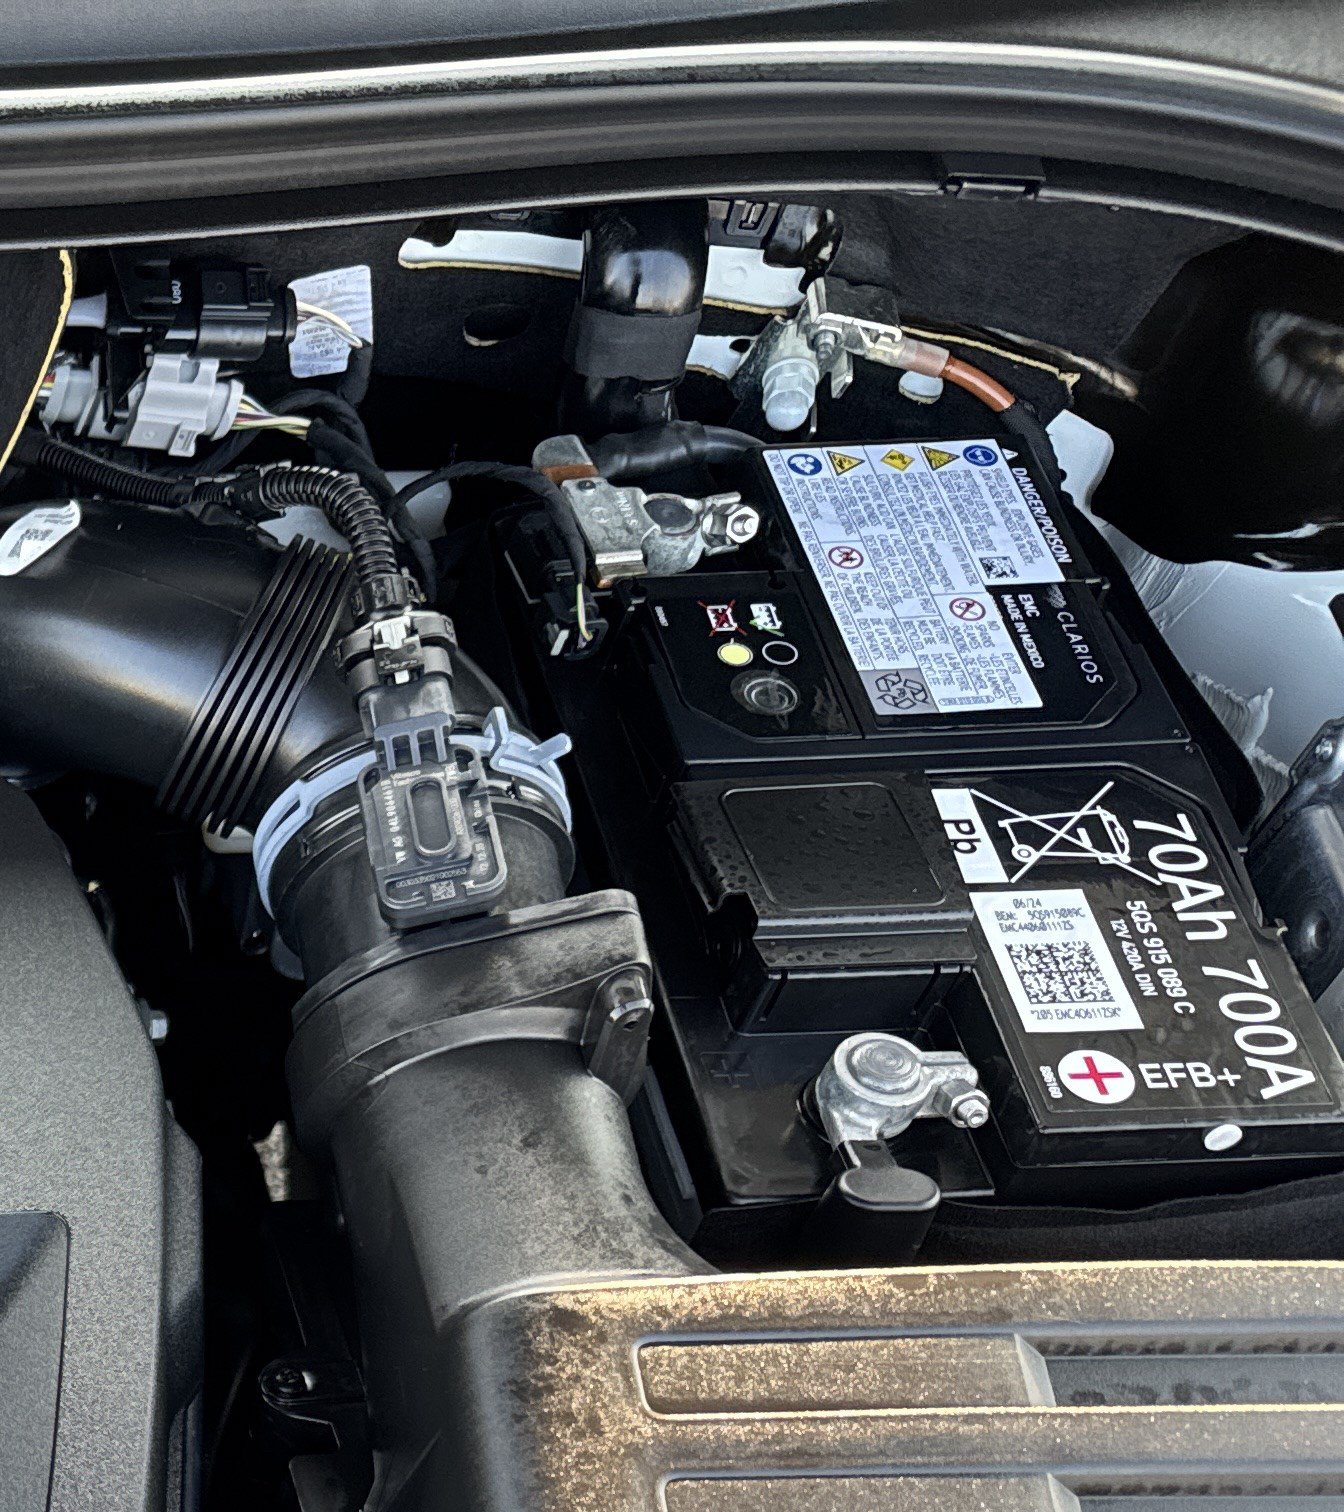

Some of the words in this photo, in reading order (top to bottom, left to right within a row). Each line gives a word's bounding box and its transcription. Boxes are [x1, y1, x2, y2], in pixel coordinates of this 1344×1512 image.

[1010, 467, 1073, 563] DANGER/POISON
[1001, 595, 1023, 621] MADE
[1018, 594, 1040, 617] EMC
[1014, 622, 1028, 632] IN
[1020, 634, 1044, 668] MEXICO
[1057, 612, 1103, 683] CLARIOS
[943, 817, 980, 854] Pb
[1110, 919, 1132, 939] 12V
[1122, 941, 1145, 971] 420A
[1135, 974, 1158, 996] DIN
[1133, 814, 1236, 940] 70Ah
[1202, 959, 1315, 1099] 700A
[1143, 938, 1172, 964] 915
[1157, 968, 1187, 997] 089
[1174, 1002, 1195, 1014] C
[1141, 1061, 1240, 1090] EFB+
